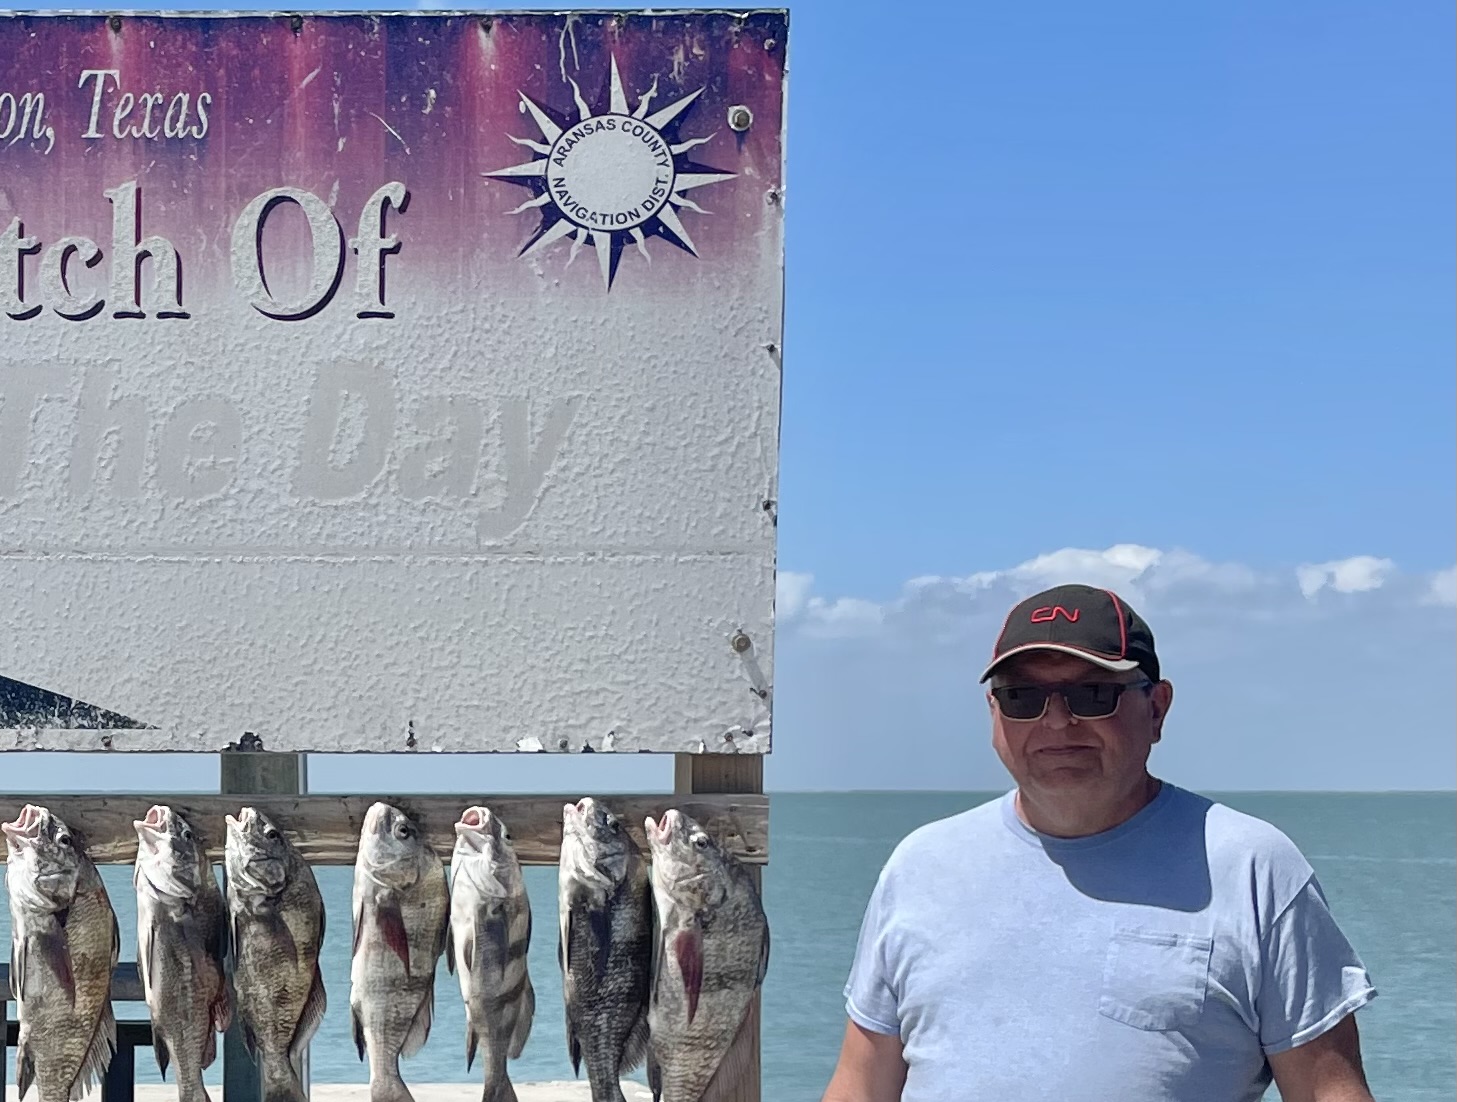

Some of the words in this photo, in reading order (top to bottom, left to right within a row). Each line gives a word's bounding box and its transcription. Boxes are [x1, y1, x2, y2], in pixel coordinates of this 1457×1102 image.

[78, 68, 212, 140] Texas
[552, 118, 617, 168] ARANSAS
[621, 120, 671, 169] COUNTY
[552, 176, 642, 226] NAVIGATION
[641, 173, 670, 213] DIST.
[230, 182, 412, 322] Of
[289, 357, 581, 546] Day
[1030, 604, 1081, 624] CN
